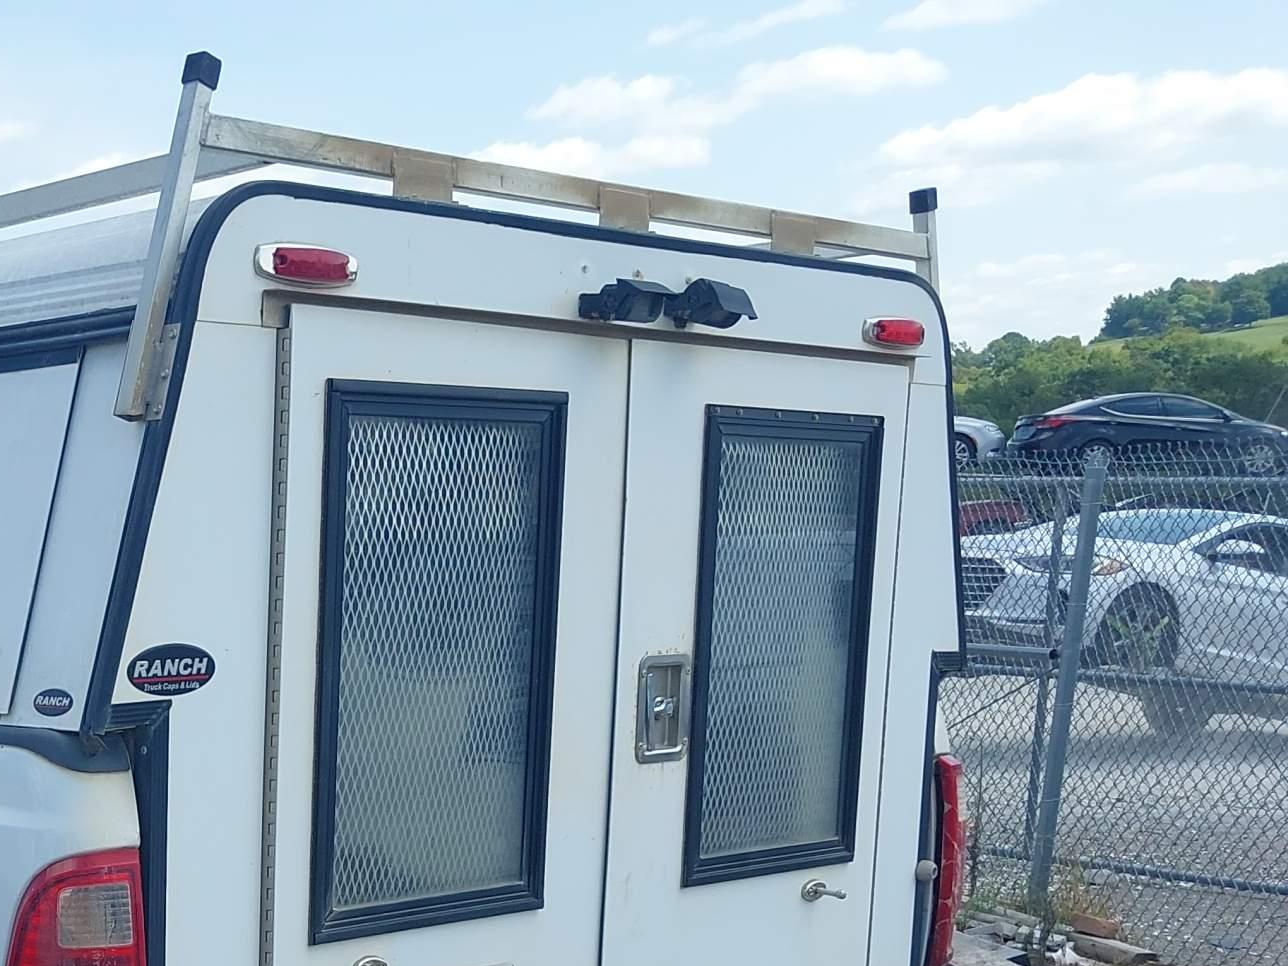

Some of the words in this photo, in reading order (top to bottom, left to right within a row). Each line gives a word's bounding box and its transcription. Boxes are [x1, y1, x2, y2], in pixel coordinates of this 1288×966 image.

[133, 656, 209, 678] RANCH
[143, 683, 162, 692] Truck
[162, 682, 178, 691] Caps
[186, 680, 200, 689] Lids
[35, 695, 71, 707] RANCH
